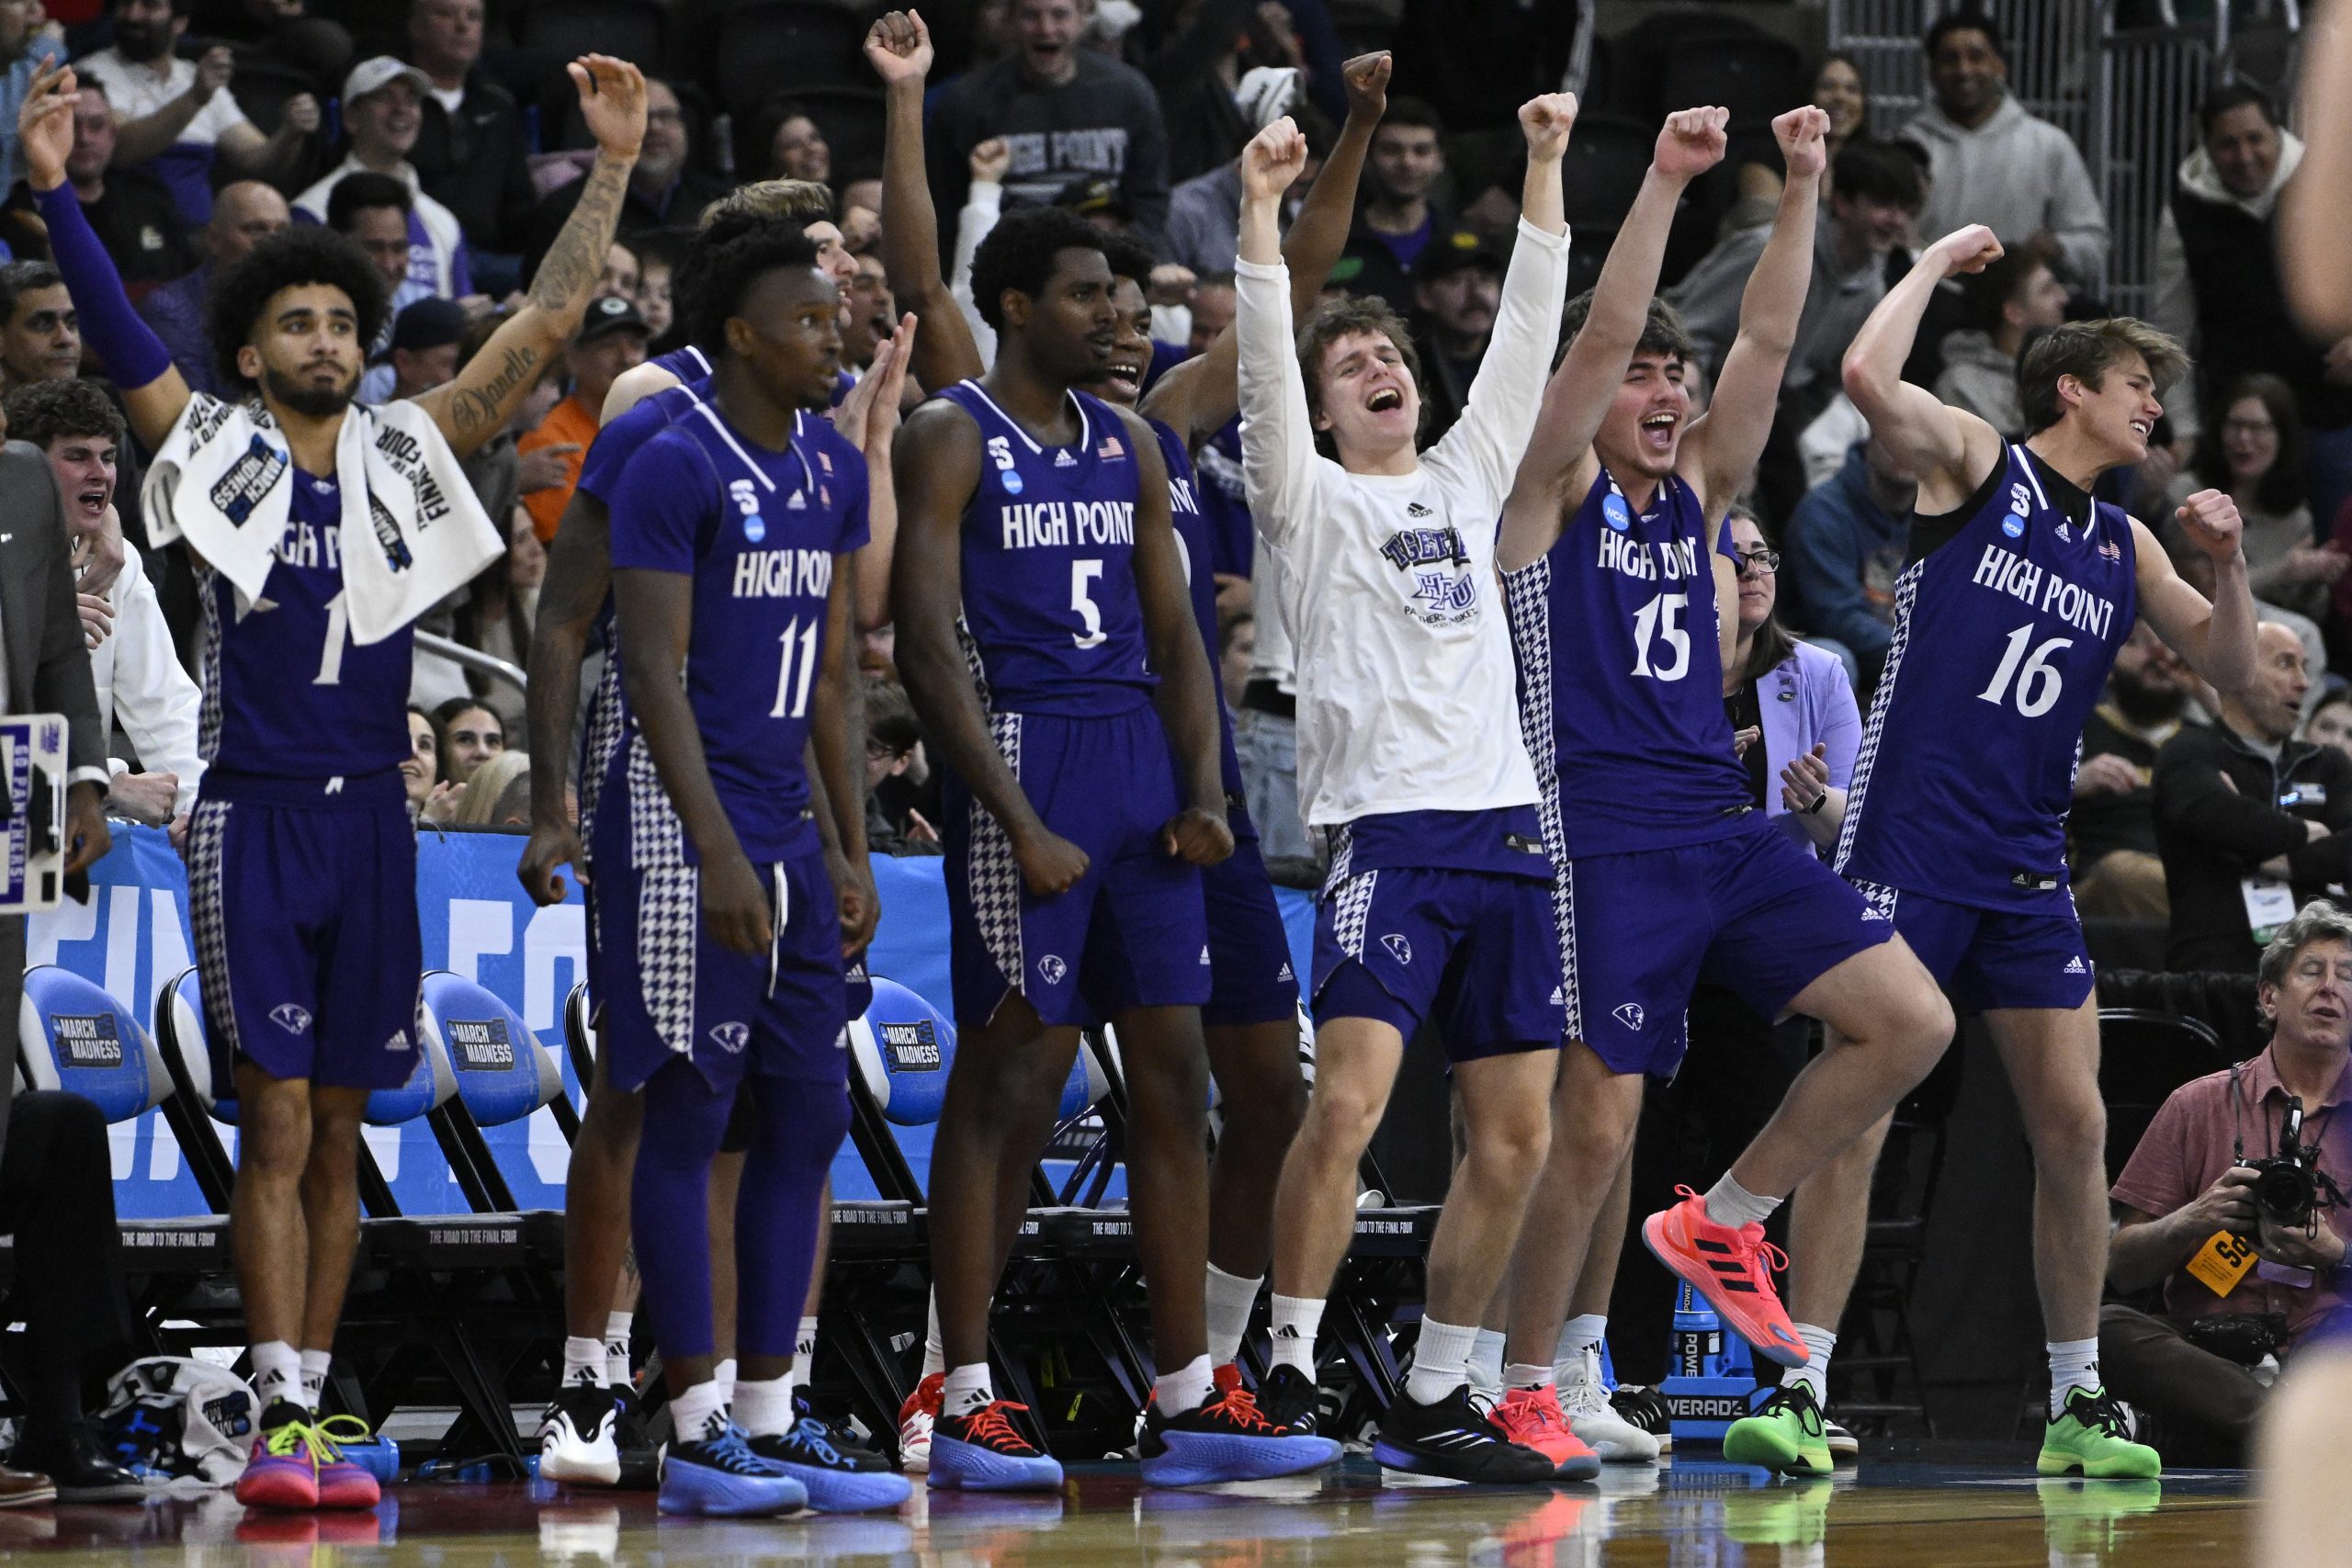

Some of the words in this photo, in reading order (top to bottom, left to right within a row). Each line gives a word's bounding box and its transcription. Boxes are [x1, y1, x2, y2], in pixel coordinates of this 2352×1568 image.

[1001, 502, 1069, 550] HIGH
[1072, 501, 1136, 547] POINT
[2003, 520, 2022, 536] NCAA
[276, 521, 319, 569] GH
[1597, 526, 1657, 581] HIGH
[732, 549, 793, 598] HIGH
[1972, 543, 2044, 606] HIGH
[2041, 573, 2115, 641] POINT
[1070, 558, 1108, 650] 5
[1404, 605, 1447, 624] PATHERS
[311, 588, 348, 685] 1
[1630, 592, 1691, 682] 15
[769, 614, 819, 718] 11
[1976, 622, 2074, 718] 16
[59, 1018, 97, 1039] MARCH
[455, 1023, 491, 1043] MARCH
[886, 1026, 919, 1045] MARCH
[70, 1038, 122, 1059] MADNESS
[464, 1043, 514, 1064] MADNESS
[895, 1044, 940, 1065] MADNESS
[831, 1210, 842, 1224] THE
[842, 1210, 858, 1224] ROAD
[858, 1210, 866, 1224] TO
[866, 1210, 877, 1224] THE
[877, 1210, 893, 1224] FINAL
[893, 1210, 908, 1224] FOUR
[430, 1230, 442, 1245] THE
[443, 1230, 460, 1245] ROAD
[459, 1230, 469, 1245] TO
[469, 1230, 482, 1245] THE
[482, 1230, 500, 1245] FINAL
[501, 1230, 517, 1245] FOUR
[1024, 1221, 1039, 1235] FOUR
[1092, 1222, 1103, 1235] THE
[1104, 1222, 1120, 1235] ROAD
[1120, 1222, 1127, 1235] TO
[1354, 1221, 1368, 1234] OAD
[1368, 1221, 1375, 1235] TO
[1375, 1221, 1385, 1235] THE
[1385, 1221, 1399, 1235] FINAL
[1400, 1221, 1413, 1235] FOUR
[122, 1232, 135, 1247] THE
[136, 1232, 155, 1247] ROAD
[155, 1232, 165, 1247] TO
[165, 1232, 179, 1247] THE
[178, 1232, 198, 1247] FINAL
[198, 1232, 216, 1247] FOUR
[1668, 1399, 1745, 1416] WERADE
